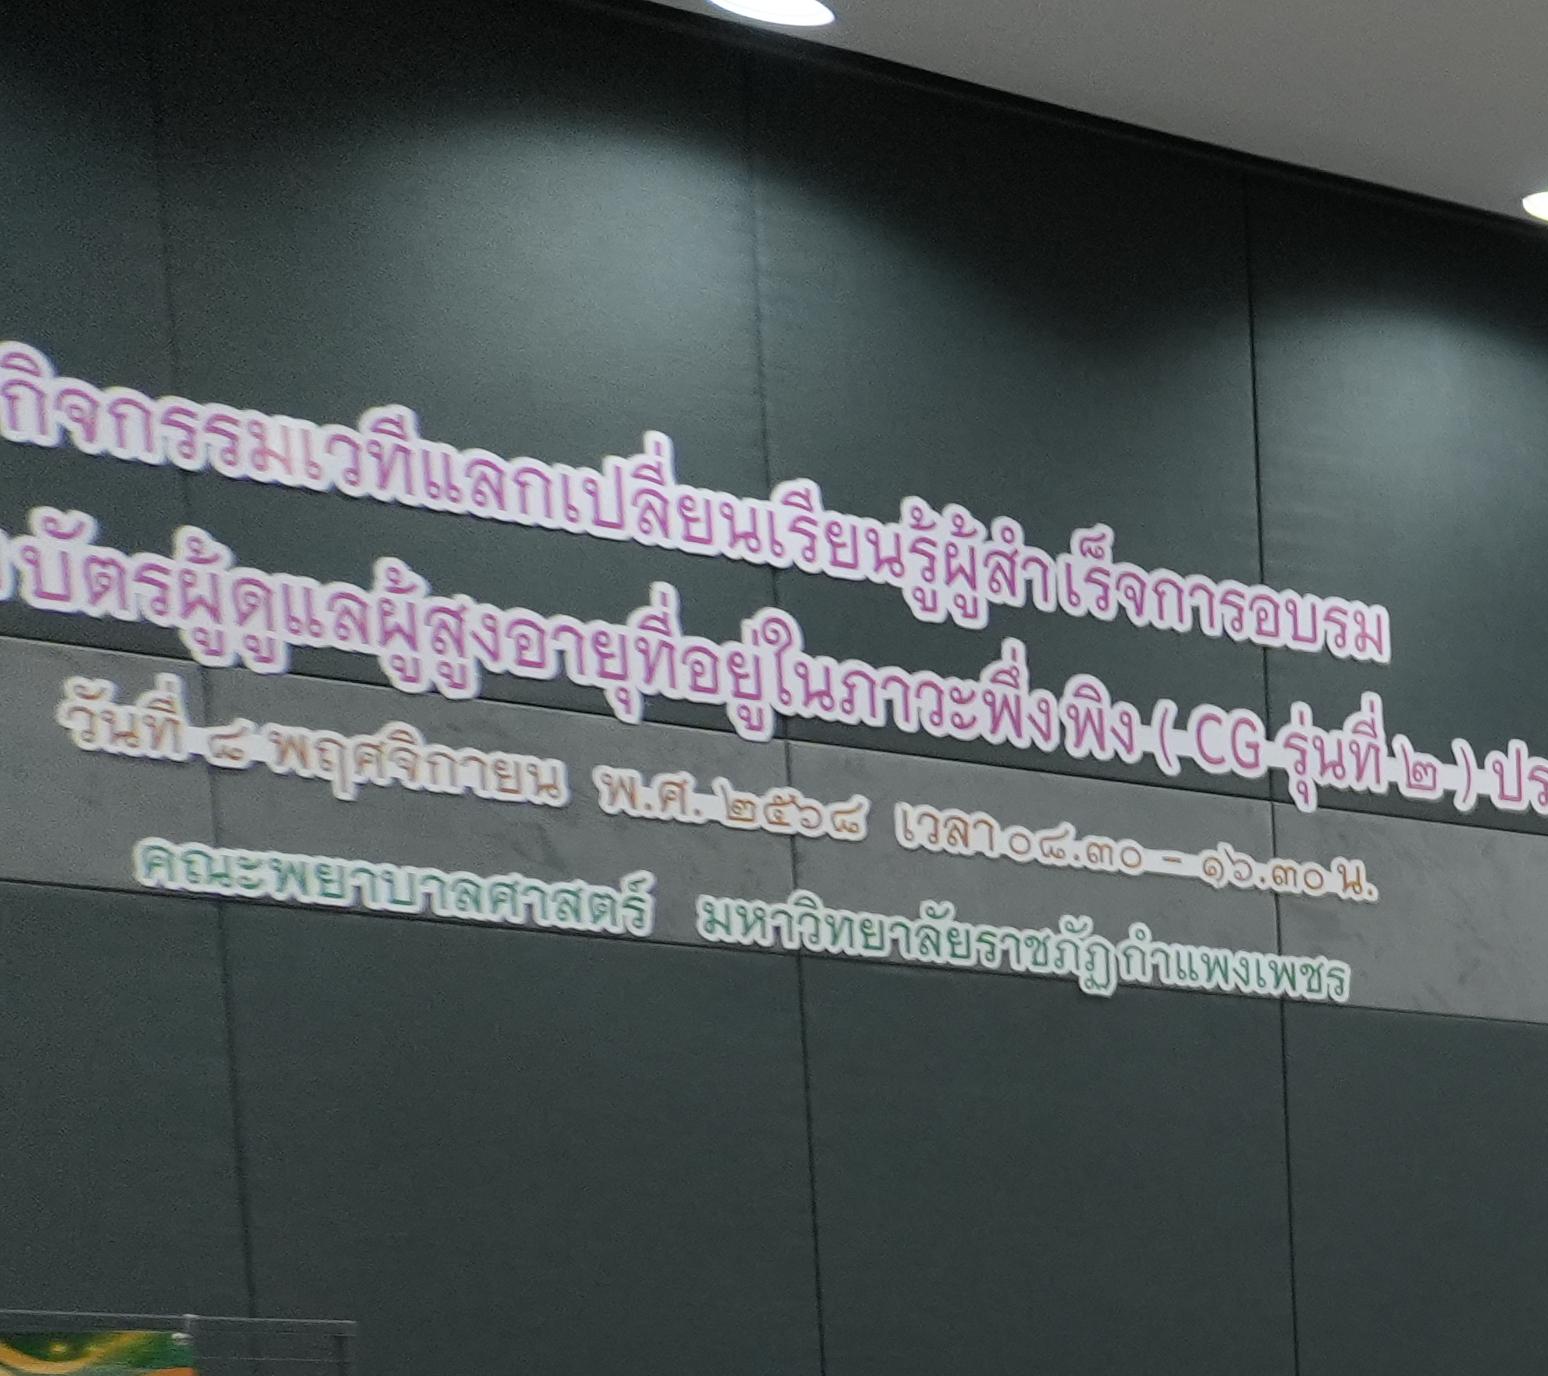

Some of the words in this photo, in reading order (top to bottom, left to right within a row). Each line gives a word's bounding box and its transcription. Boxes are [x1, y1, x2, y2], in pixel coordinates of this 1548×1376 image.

[0, 513, 1136, 755] บัตรผู้ดูแลผู้สูงอายุที่อยู่ในภาวะพึ่งพิง
[64, 677, 183, 751] วันที่
[268, 728, 566, 799] พฤศจิกายน
[140, 842, 648, 930] คณะพยาบาลศาสตร์
